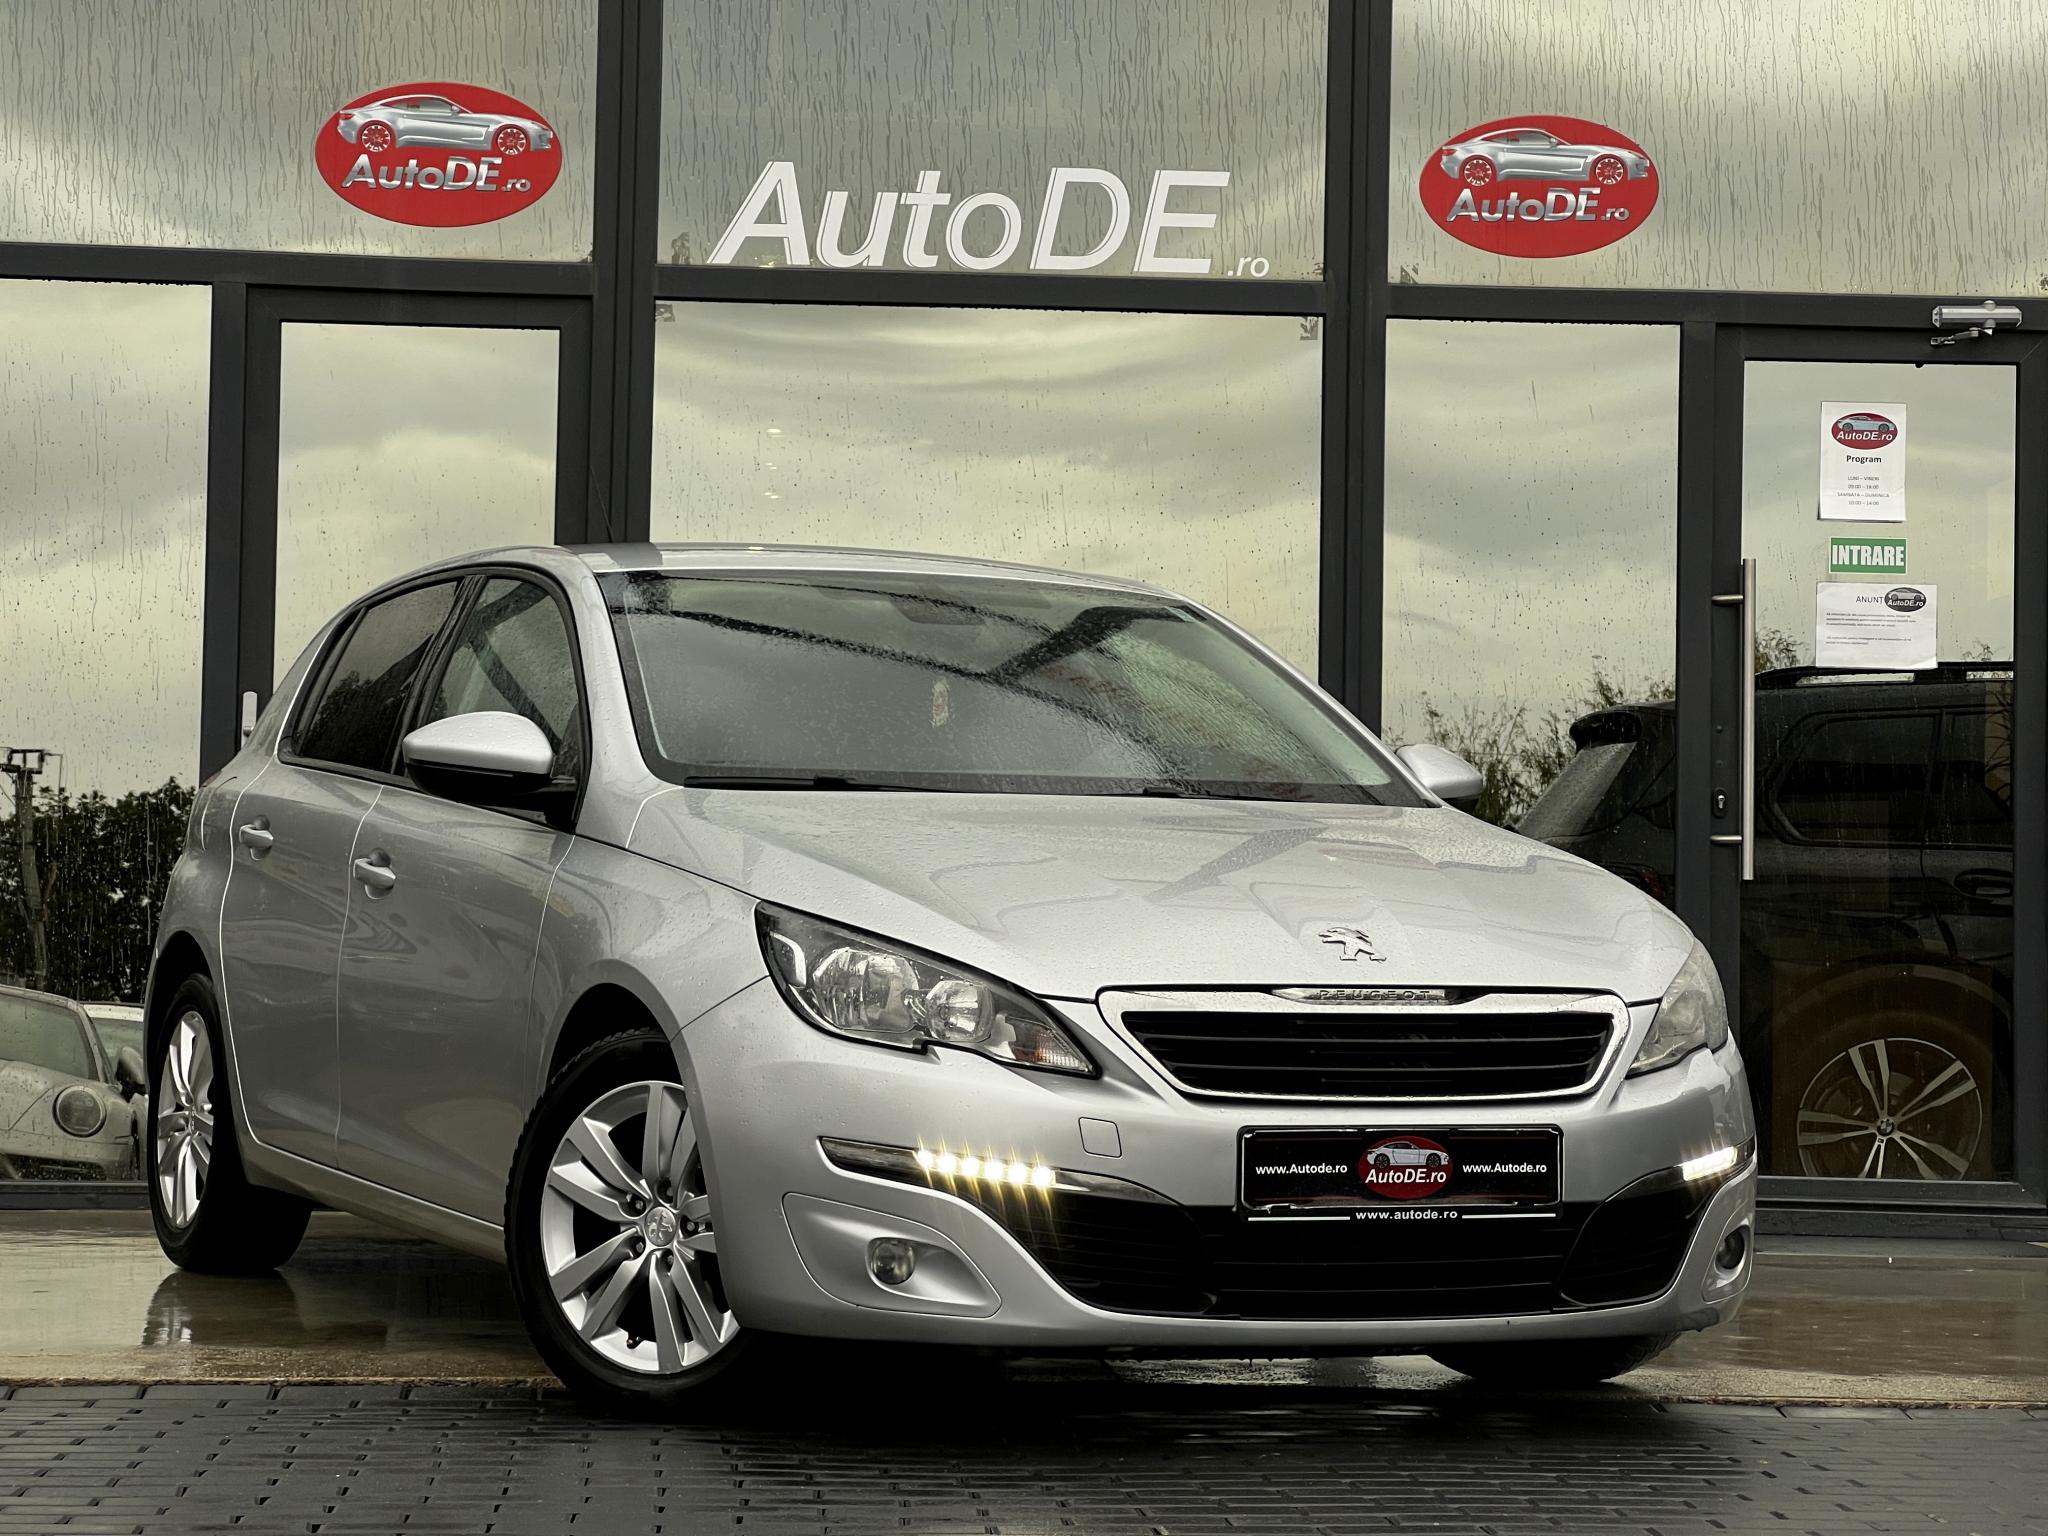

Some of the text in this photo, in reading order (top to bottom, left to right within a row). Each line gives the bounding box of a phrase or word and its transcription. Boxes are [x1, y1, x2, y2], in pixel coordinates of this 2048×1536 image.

[1836, 430, 1893, 442] AutoDE.ro
[1846, 454, 1882, 465] Program
[1832, 545, 1905, 566] INTRARE
[1887, 599, 1924, 607] AutoDE.ro
[1319, 989, 1431, 1000] PEUGEOT
[1255, 1162, 1547, 1184] www.Autode.ro AutoDE.ro www.Autode.ro
[1355, 1209, 1458, 1220] www.autode.ro
